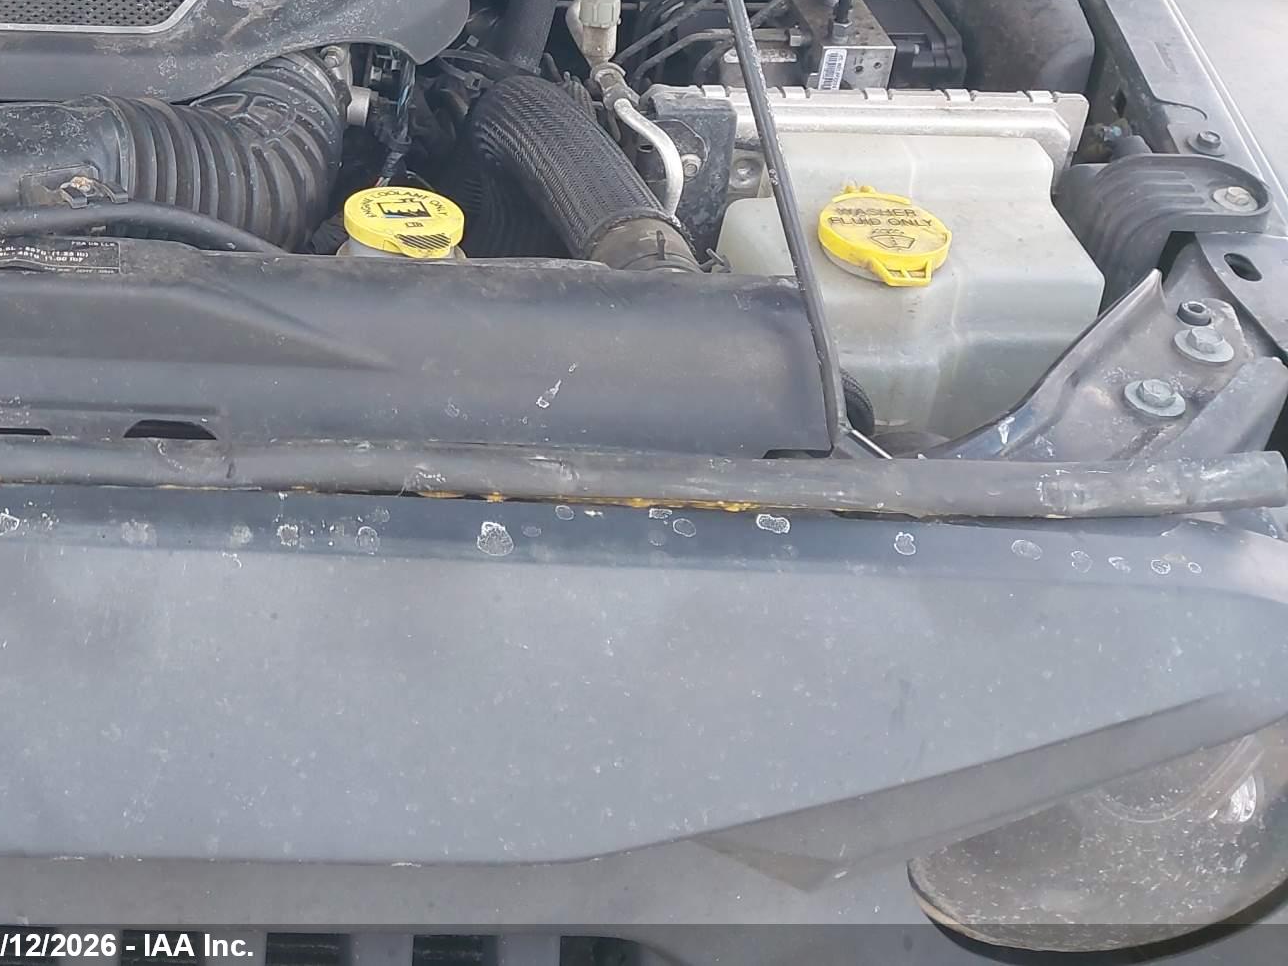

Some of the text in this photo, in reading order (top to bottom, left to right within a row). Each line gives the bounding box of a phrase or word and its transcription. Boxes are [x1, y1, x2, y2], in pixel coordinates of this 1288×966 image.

[373, 189, 430, 201] COOLANT
[429, 198, 449, 217] ONLY
[835, 207, 917, 217] WASHER
[828, 216, 934, 227] FLUID ONLY
